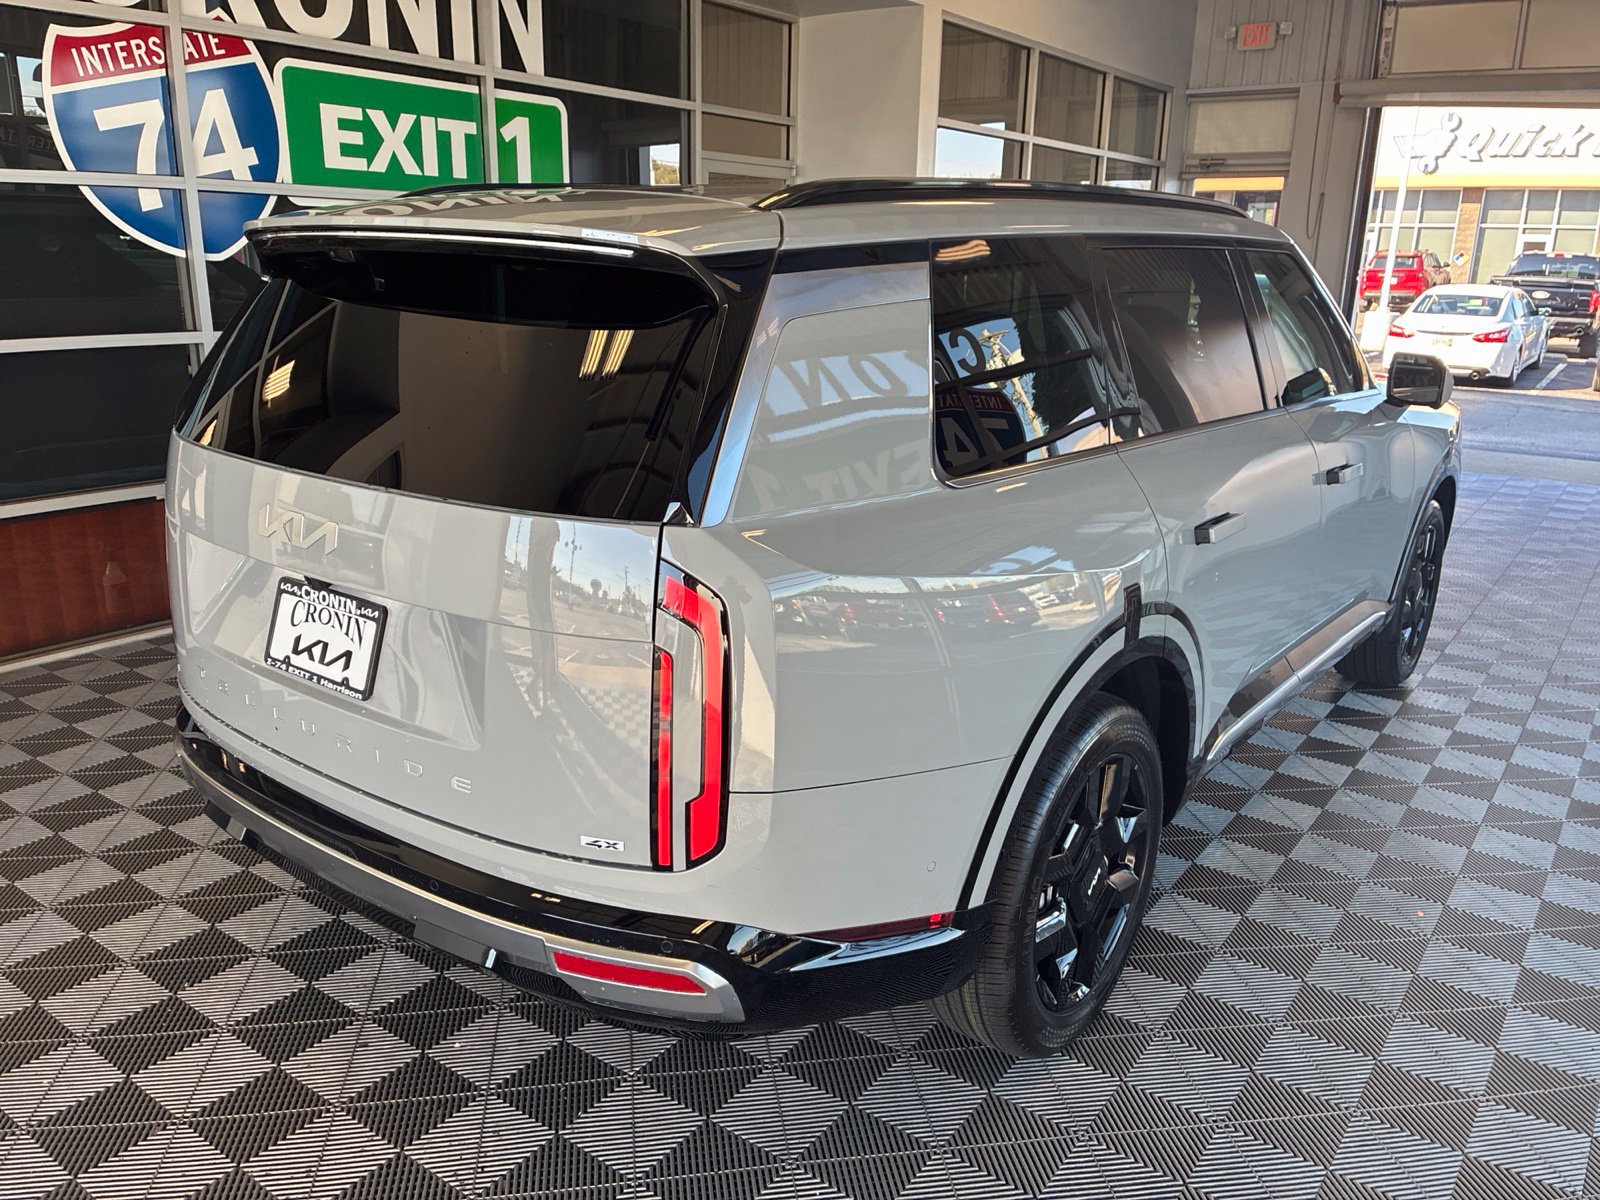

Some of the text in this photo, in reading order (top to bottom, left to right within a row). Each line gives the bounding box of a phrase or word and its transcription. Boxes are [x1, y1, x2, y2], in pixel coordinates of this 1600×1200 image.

[71, 33, 226, 78] INTERSATE
[1244, 22, 1272, 48] EXIT
[93, 89, 259, 212] 74
[319, 103, 531, 184] EXIT 1
[1458, 122, 1595, 162] Quick
[257, 503, 339, 555] KIA
[301, 585, 357, 615] CRONIN
[291, 600, 367, 651] CRONIN
[291, 633, 353, 673] KIA
[266, 658, 363, 700] I-74 EXIT 1 Harrison
